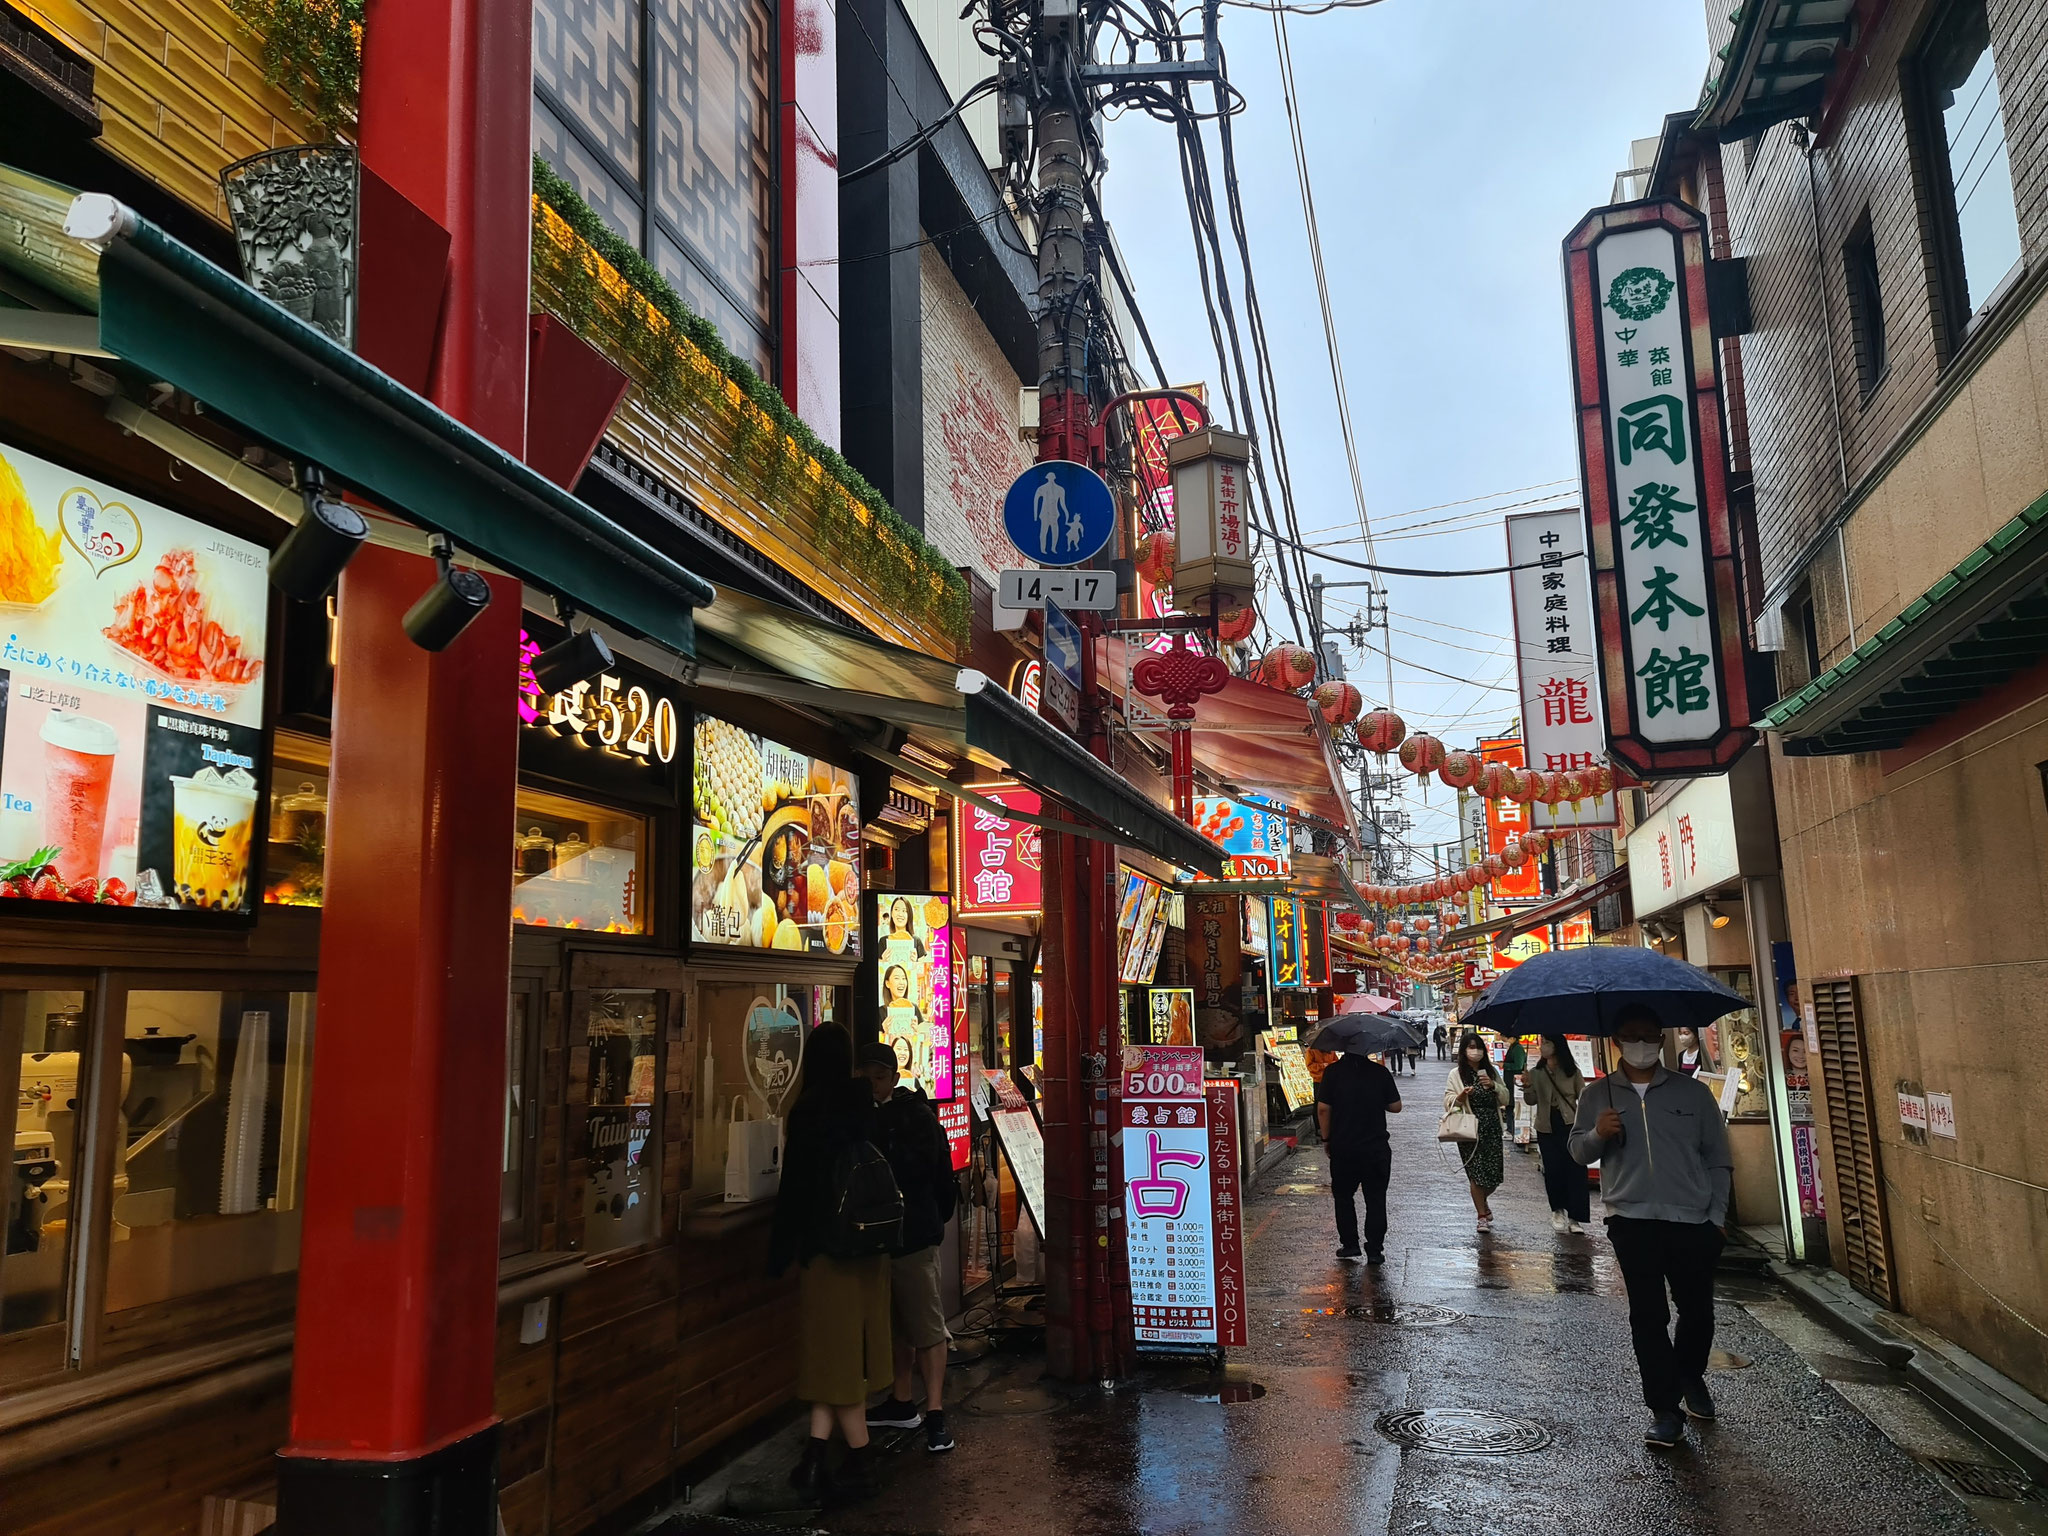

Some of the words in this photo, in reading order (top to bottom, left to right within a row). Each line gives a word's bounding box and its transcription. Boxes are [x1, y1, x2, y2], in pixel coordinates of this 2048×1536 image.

[1615, 327, 1638, 367] 中華
[1648, 346, 1672, 387] 菜館
[1219, 464, 1241, 556] 中華街市場通り
[1617, 393, 1710, 719] 同發本館
[1538, 530, 1572, 655] 中国家庭料理
[1049, 675, 1076, 721] ここから
[201, 742, 254, 769] Tapioca
[4, 793, 32, 812] Tea
[1242, 854, 1286, 876] No.1
[1142, 1050, 1201, 1063] キャンペーン
[1131, 1105, 1197, 1125] 愛占館
[1211, 1089, 1231, 1169] よく当たる
[1128, 1130, 1206, 1220] 占
[1215, 1173, 1235, 1255] 中華街占い
